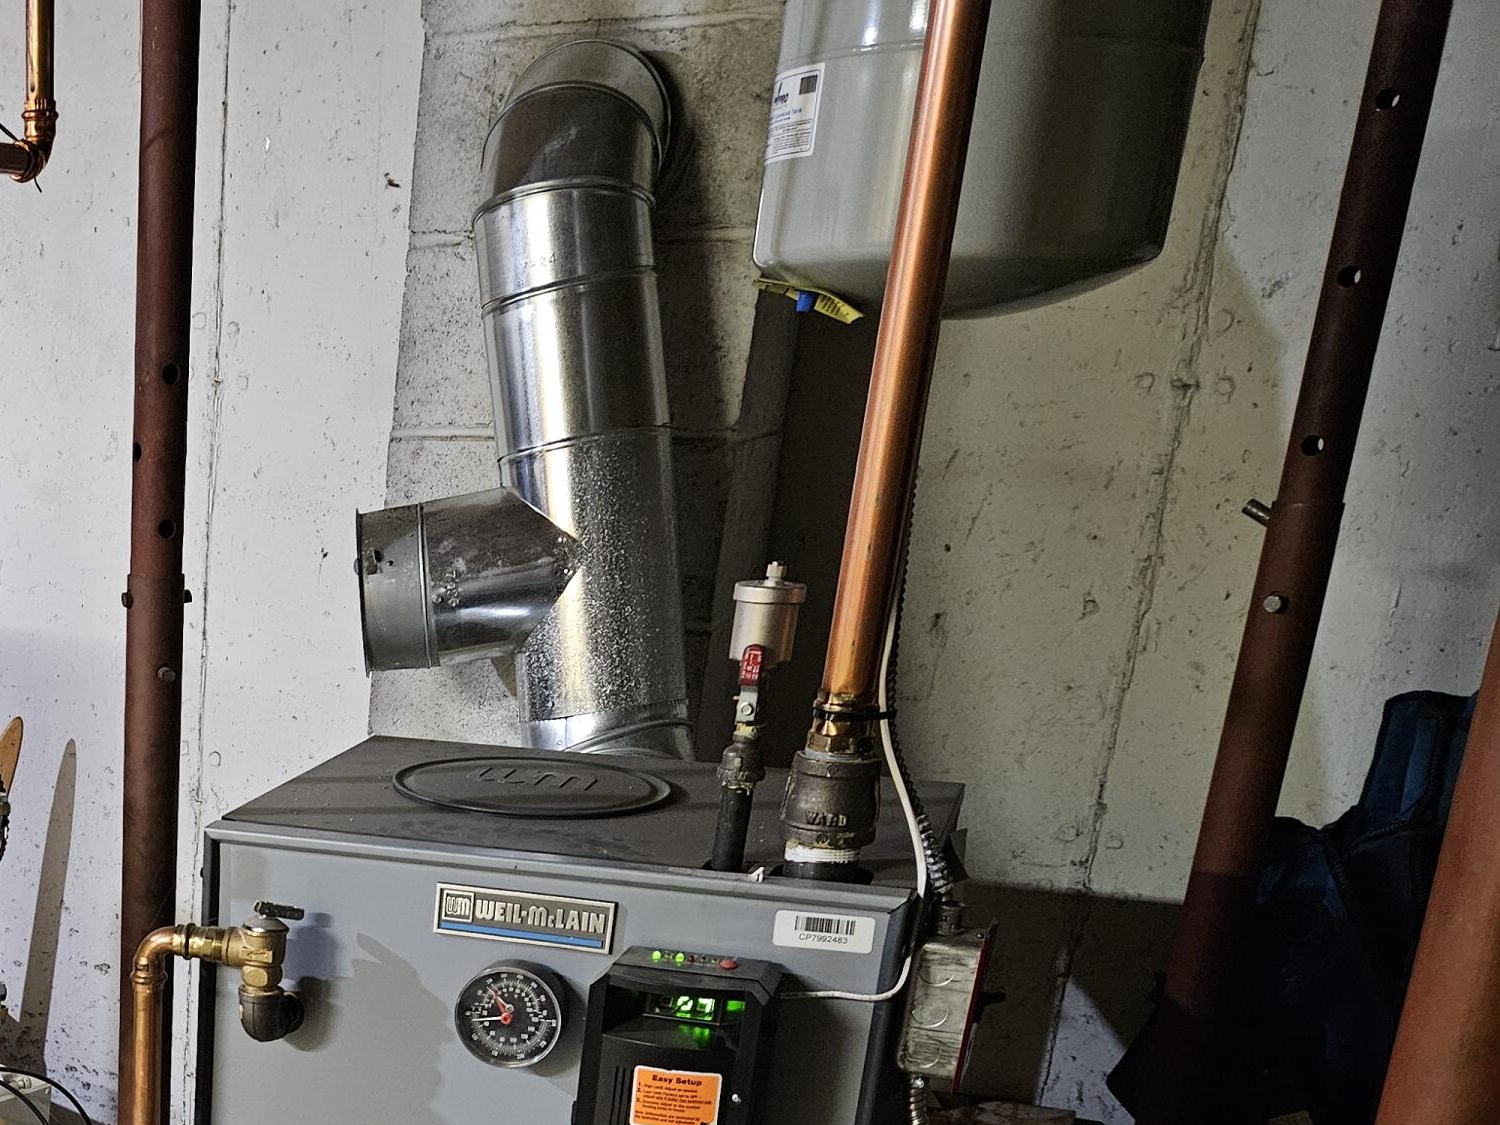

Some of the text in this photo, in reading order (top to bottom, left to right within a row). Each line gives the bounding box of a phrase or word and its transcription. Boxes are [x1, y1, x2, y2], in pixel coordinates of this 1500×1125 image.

[805, 811, 847, 828] WARD
[798, 933, 848, 945] CP7992483
[652, 1074, 702, 1087] Easy Setup
